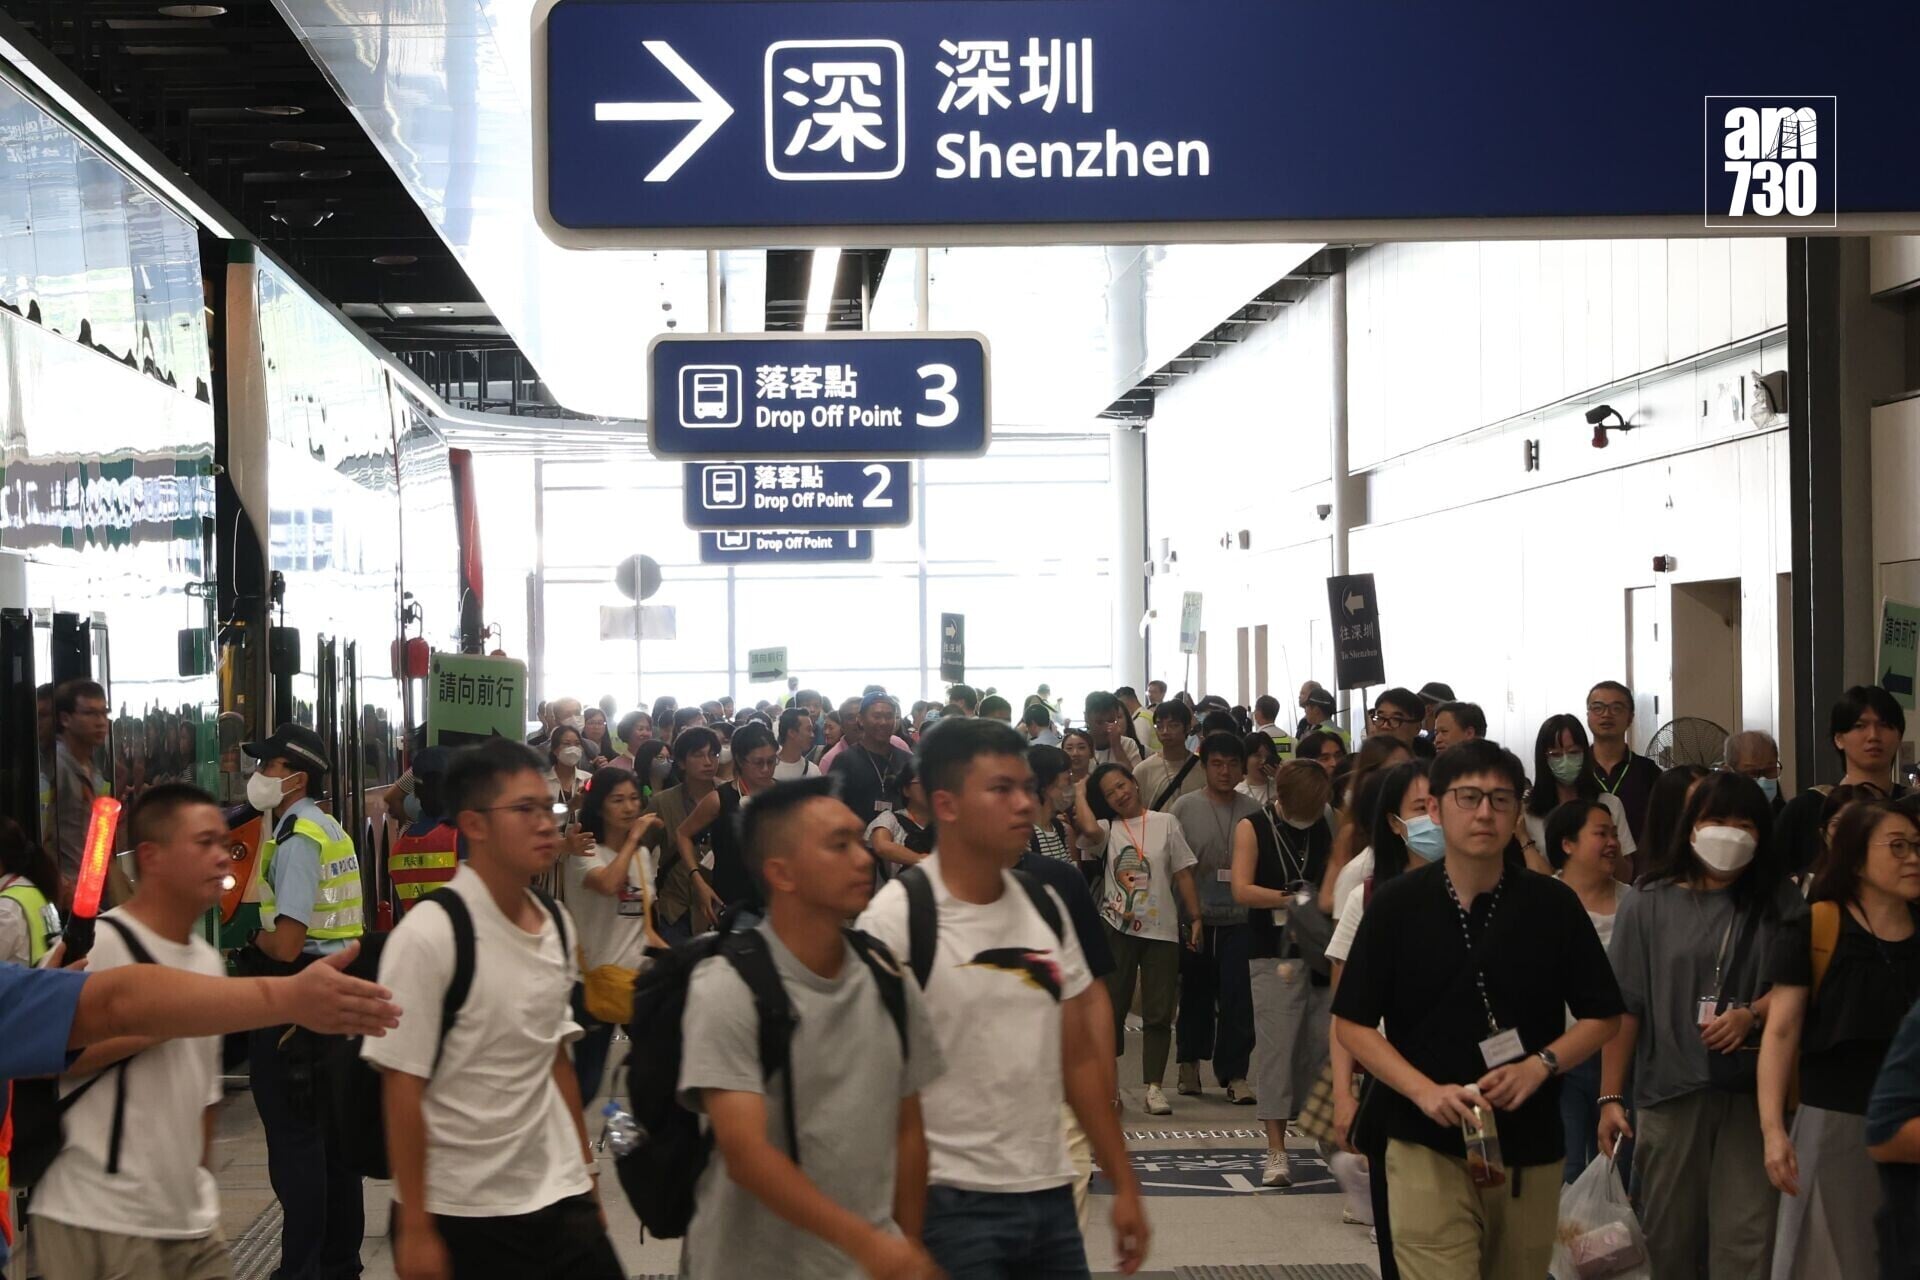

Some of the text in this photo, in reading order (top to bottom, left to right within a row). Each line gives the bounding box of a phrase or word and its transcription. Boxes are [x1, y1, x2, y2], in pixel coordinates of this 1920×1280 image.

[936, 37, 1093, 115] 深圳
[783, 62, 886, 162] 深
[935, 128, 1210, 179] Shenzhen
[755, 364, 858, 400] 落客點
[916, 363, 960, 428] 3
[756, 404, 902, 434] Drop Off Point
[754, 464, 824, 490] 落客點
[862, 463, 893, 508] 2
[754, 492, 854, 512] Drop Off Point
[756, 536, 833, 552] Drop Off Point
[1339, 621, 1373, 642] 往深圳
[439, 671, 514, 708] 請向前行
